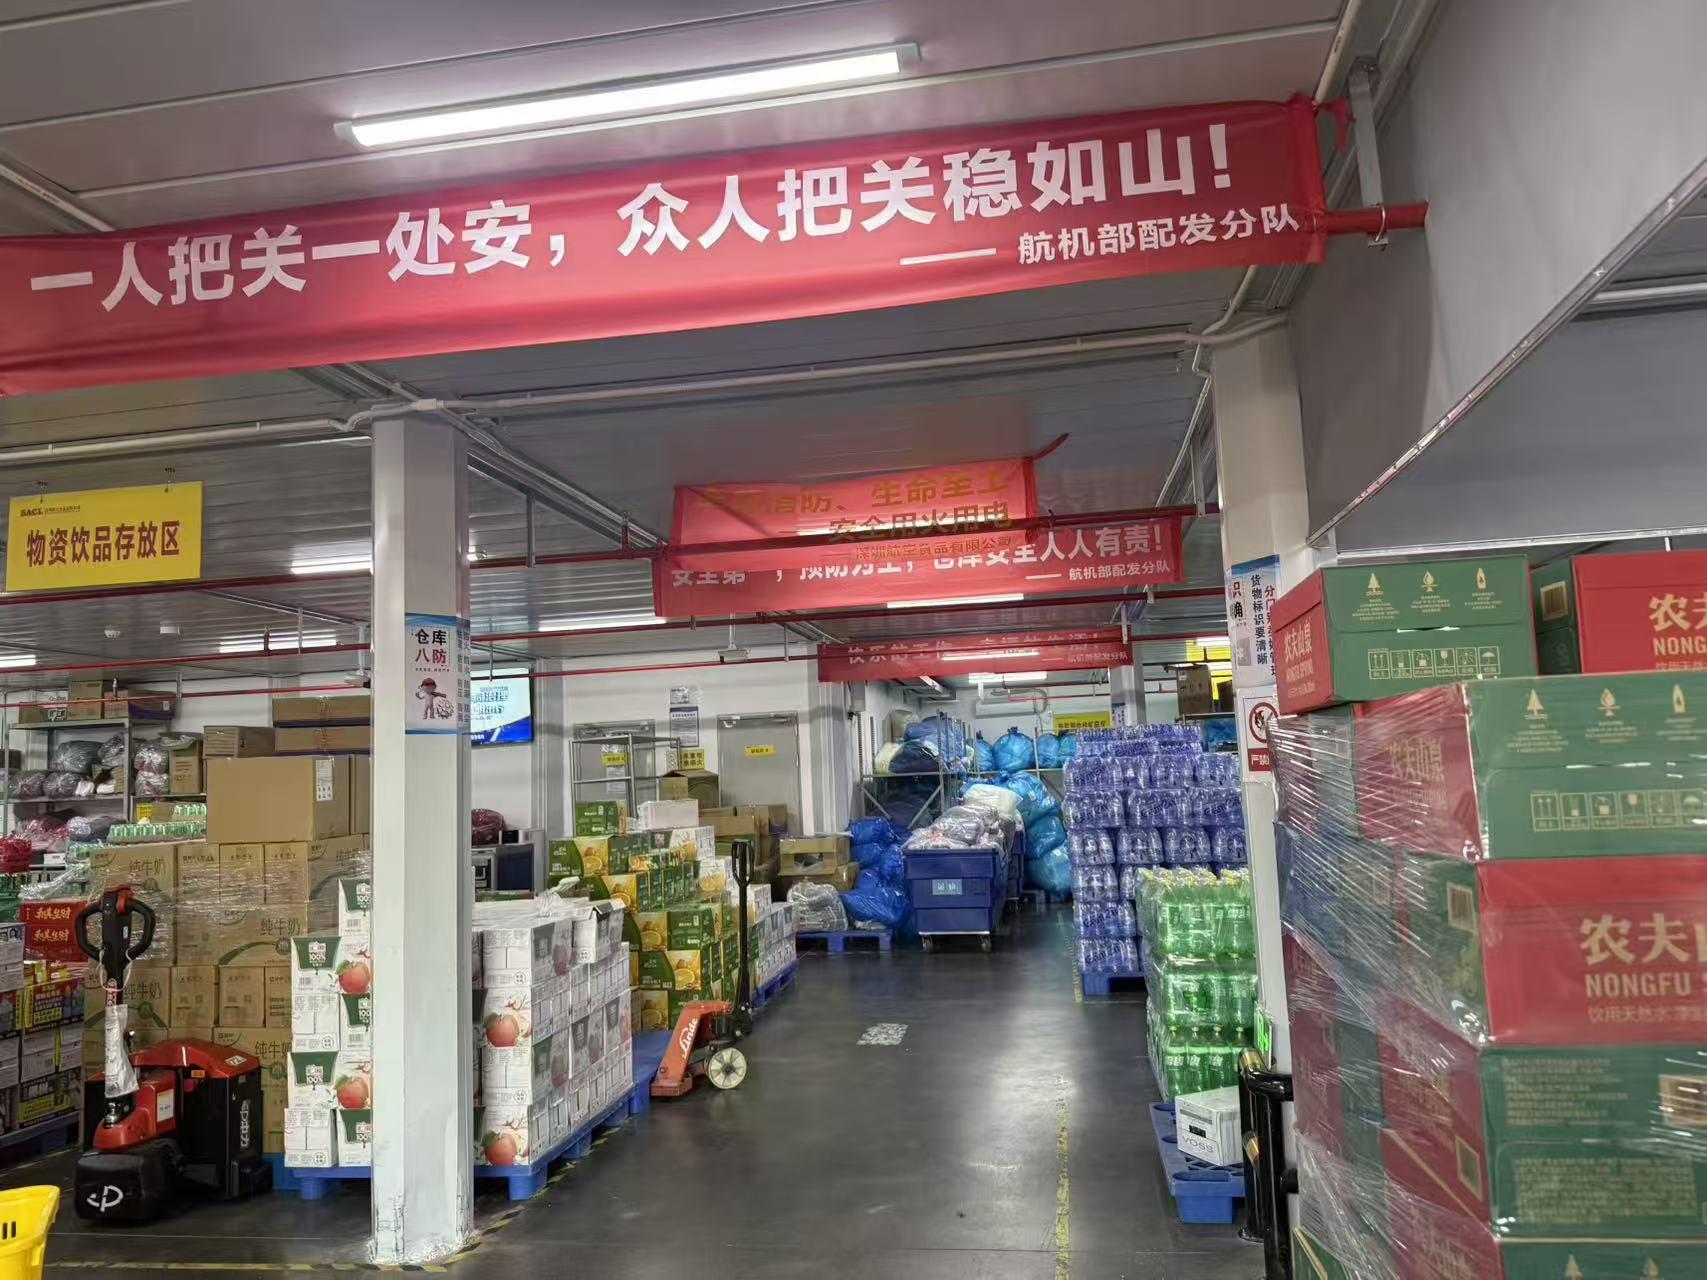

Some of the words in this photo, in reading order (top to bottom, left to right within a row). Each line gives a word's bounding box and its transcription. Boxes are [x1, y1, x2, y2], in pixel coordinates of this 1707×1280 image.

[27, 519, 181, 567] 物资饮品存放区
[1251, 574, 1268, 665] 货物标识要清晰
[415, 628, 447, 646] 仓库
[415, 648, 447, 664] 八防
[1585, 972, 1692, 998] NONGFU
[679, 1017, 698, 1059] Linde
[1182, 1134, 1214, 1154] VOSS
